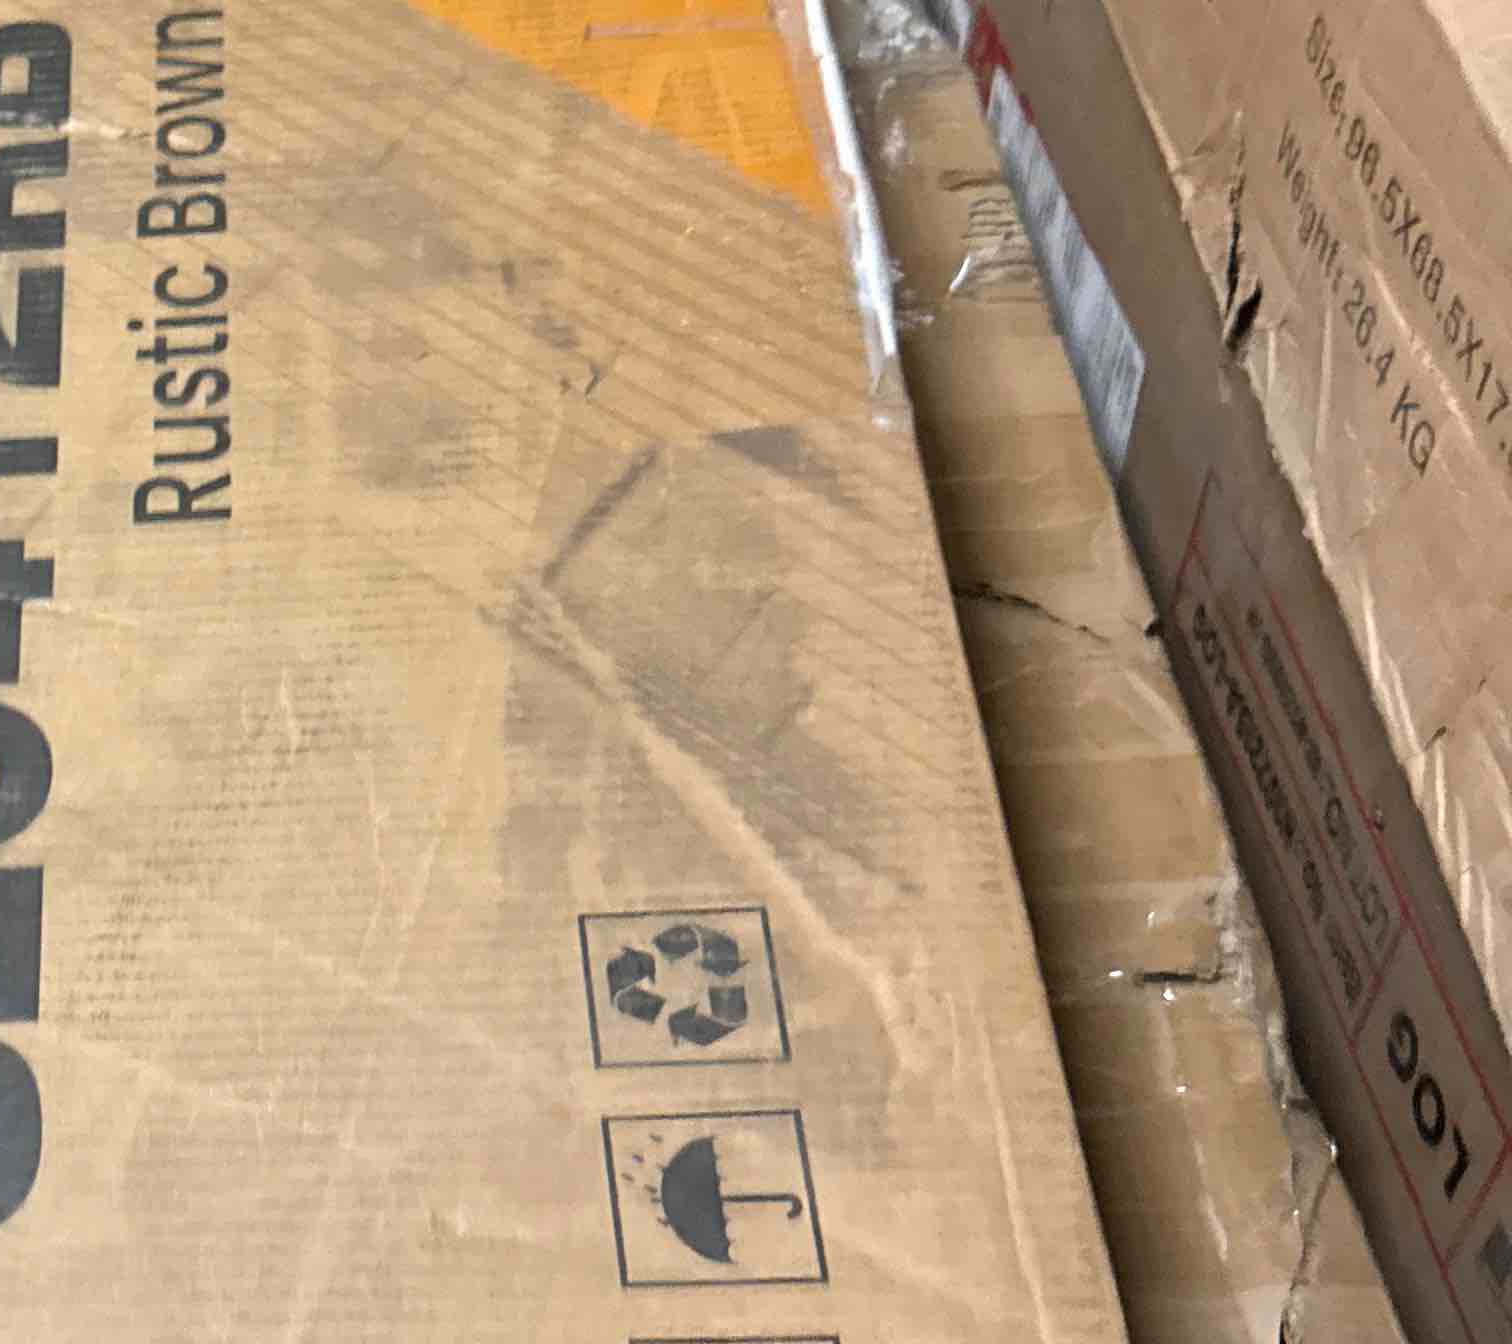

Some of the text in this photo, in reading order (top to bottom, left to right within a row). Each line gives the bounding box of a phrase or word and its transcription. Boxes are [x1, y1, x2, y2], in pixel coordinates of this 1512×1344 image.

[127, 6, 233, 524] Rustic Brown
[1390, 383, 1437, 478] KG
[1388, 1010, 1470, 1202] LOG
